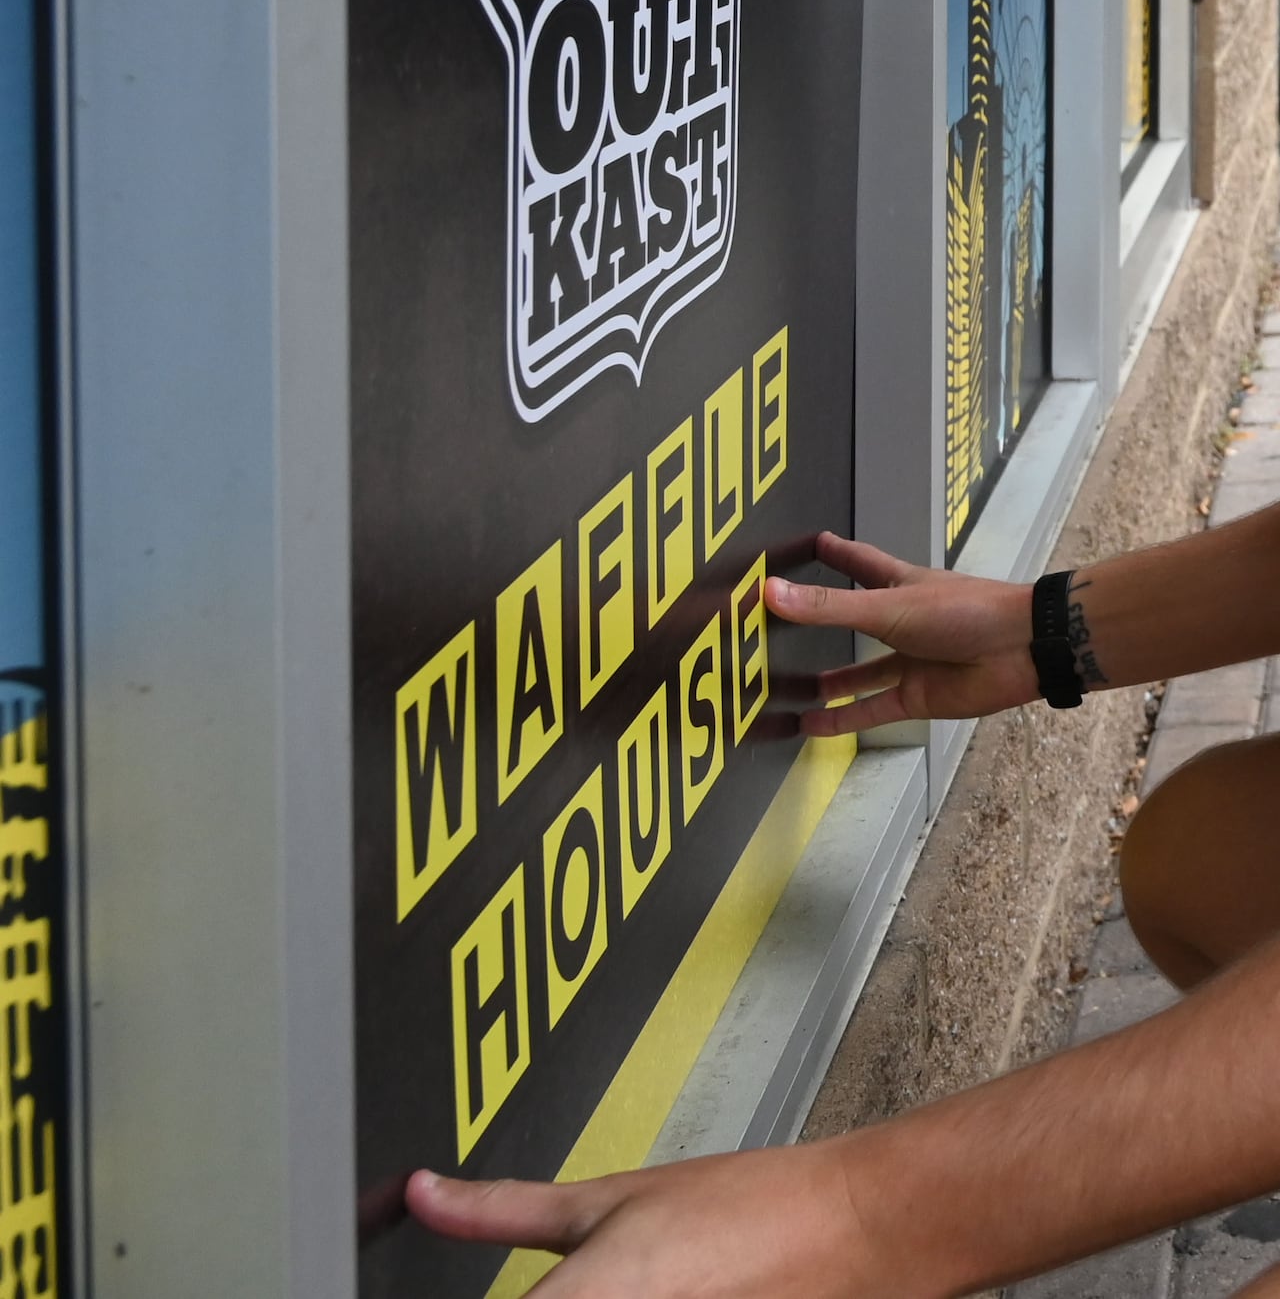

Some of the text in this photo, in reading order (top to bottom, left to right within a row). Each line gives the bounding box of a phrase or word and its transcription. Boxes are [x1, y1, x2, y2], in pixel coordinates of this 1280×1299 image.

[527, 119, 729, 343] KAST
[401, 342, 786, 882] WAFFLE
[461, 572, 766, 1145] HOUSE
